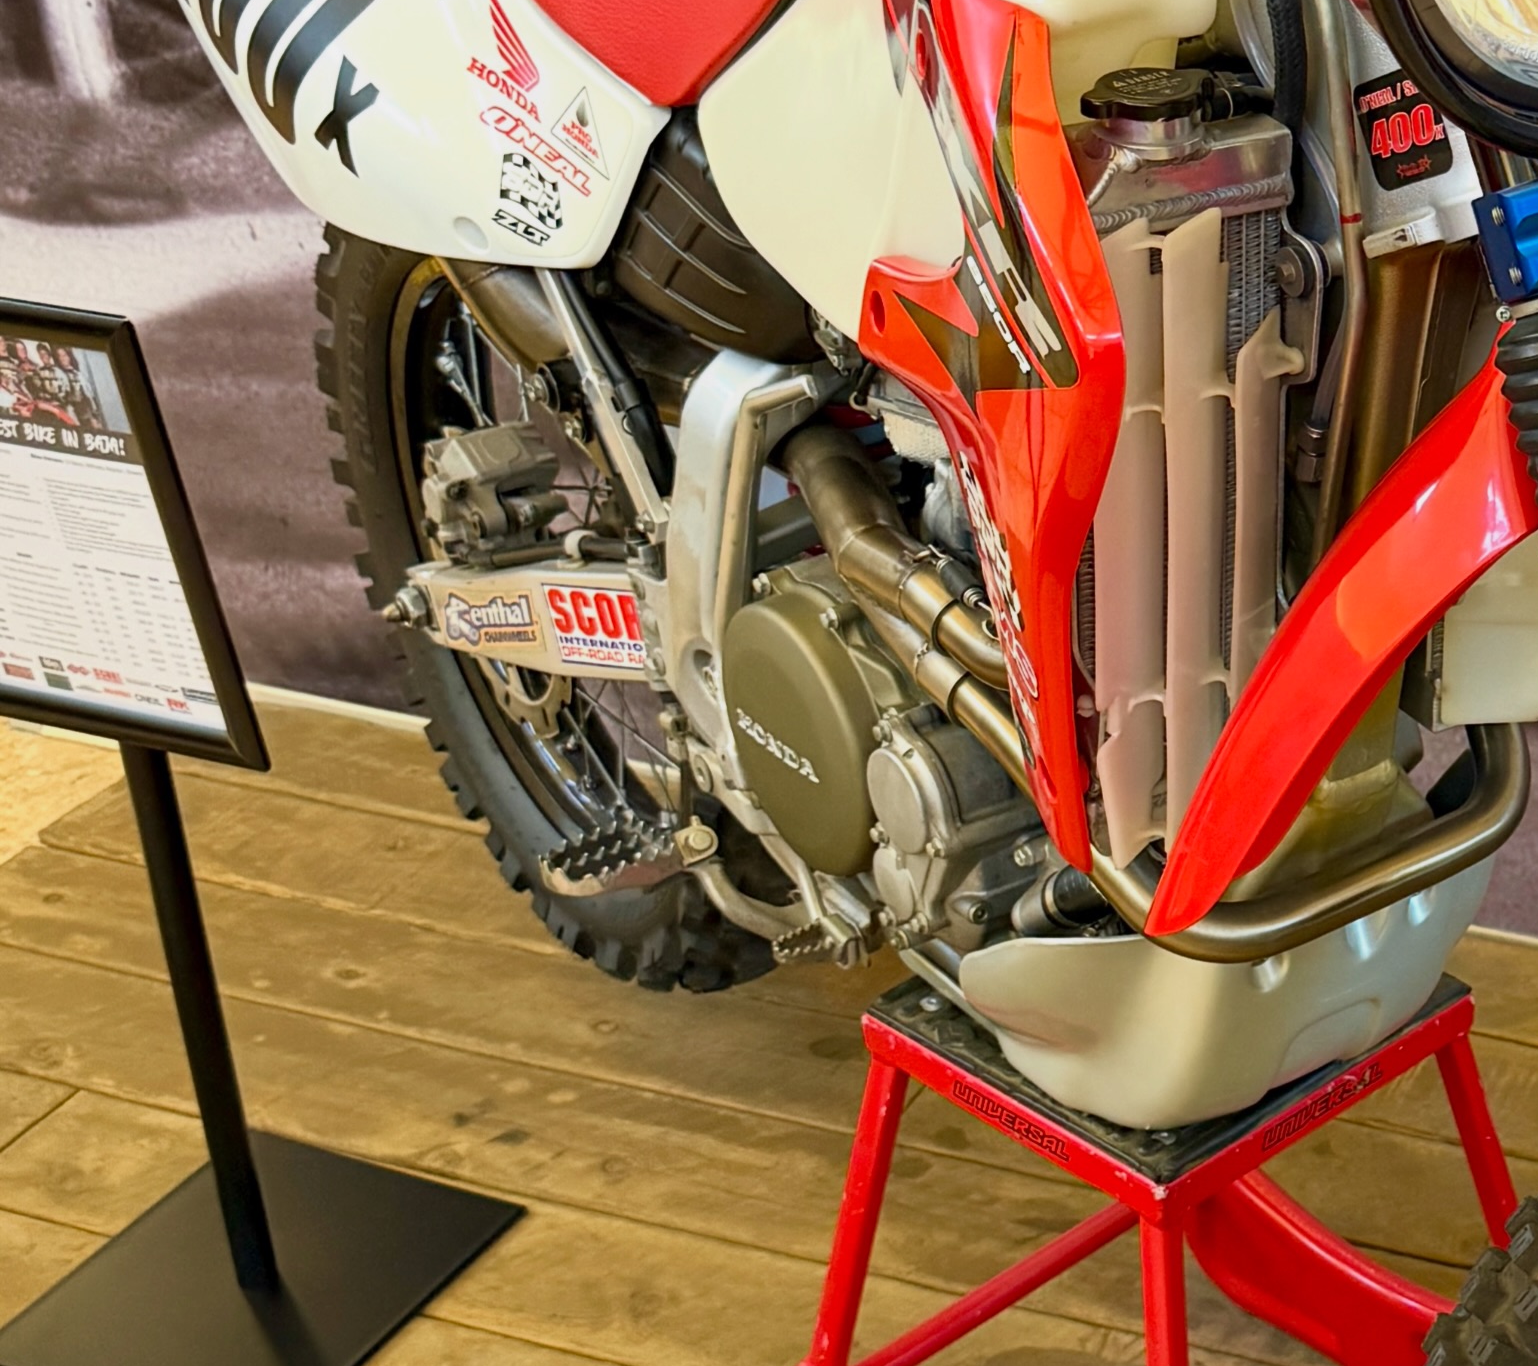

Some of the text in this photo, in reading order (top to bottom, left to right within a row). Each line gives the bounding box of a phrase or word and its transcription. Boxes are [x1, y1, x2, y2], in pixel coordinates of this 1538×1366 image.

[467, 56, 542, 124] HONDA
[479, 105, 592, 197] O'NEAL
[24, 422, 57, 445] BIKE
[61, 428, 80, 449] IN
[736, 708, 820, 784] HONDA
[953, 1080, 1070, 1162] UNIVERSAL
[1262, 1062, 1384, 1152] UNIVERSAL
